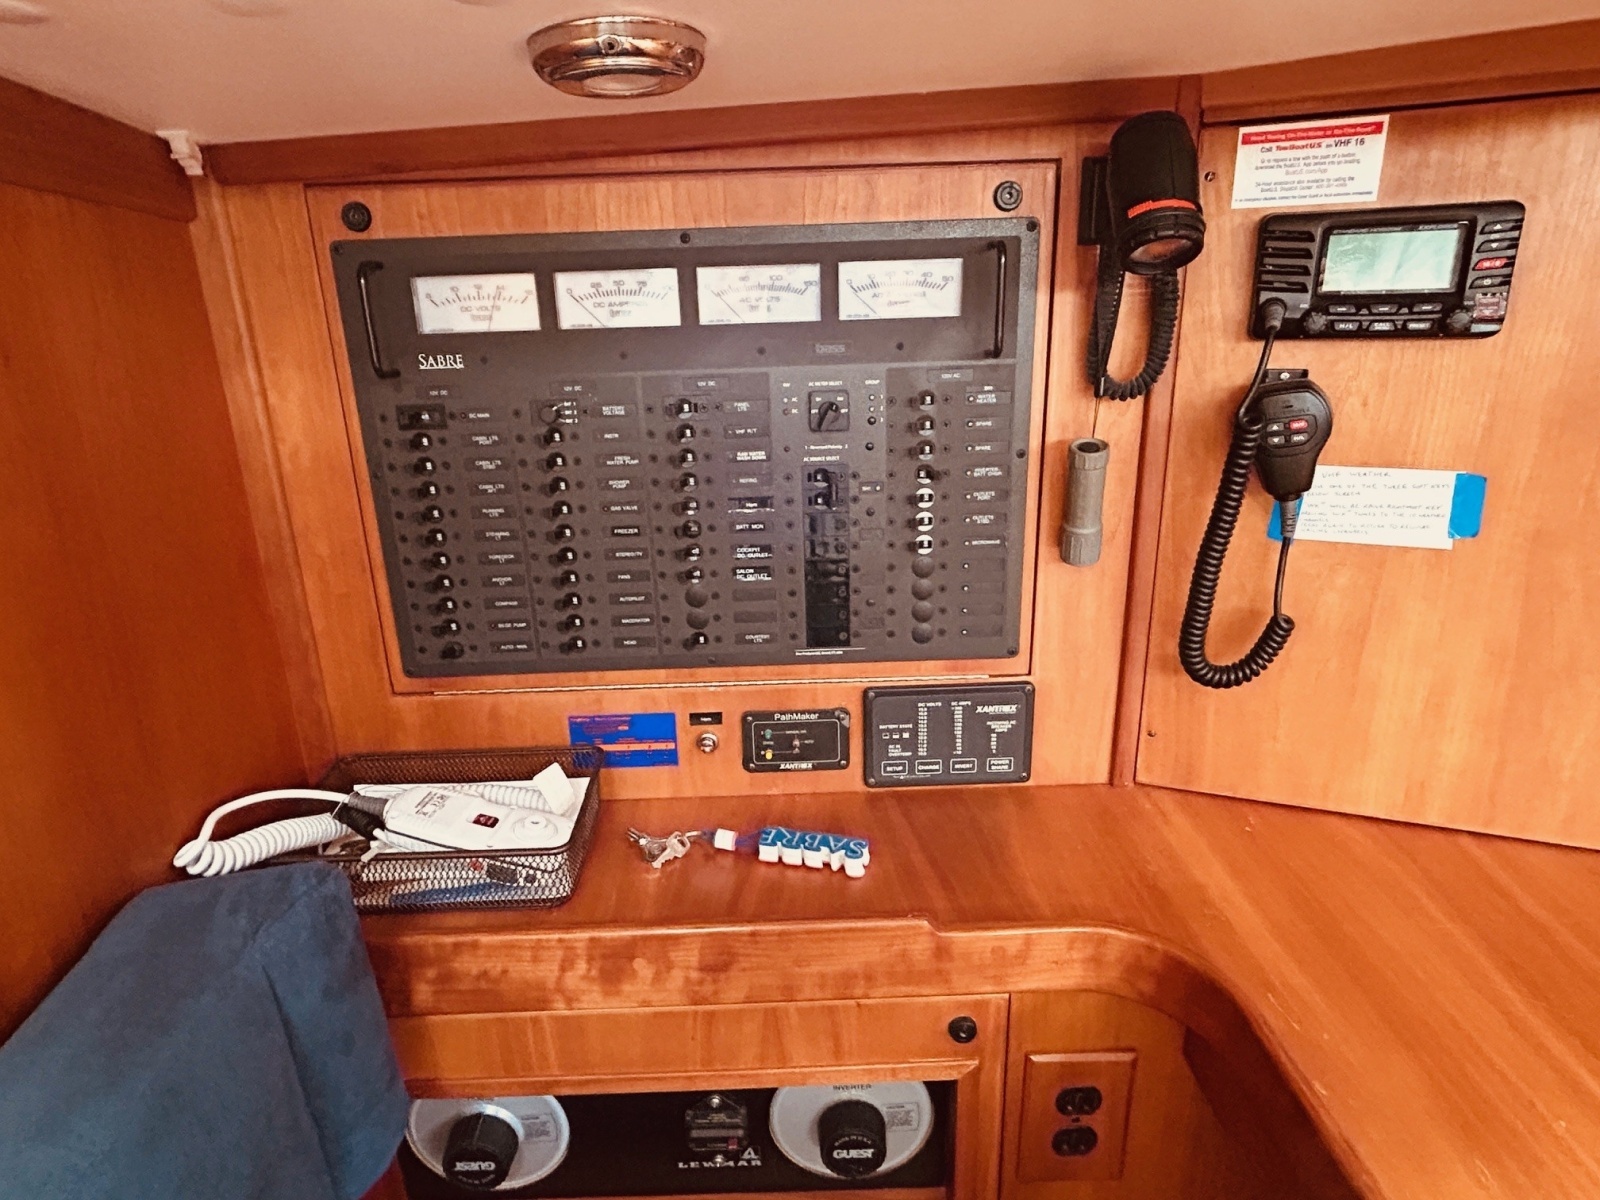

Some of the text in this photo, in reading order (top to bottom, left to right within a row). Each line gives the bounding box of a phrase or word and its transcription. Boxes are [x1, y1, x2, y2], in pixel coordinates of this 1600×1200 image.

[1334, 138, 1351, 147] VHF
[418, 353, 464, 369] SABRE
[976, 705, 1018, 713] XANTREX
[760, 826, 869, 859] SABRE
[832, 1148, 875, 1159] GUEST
[454, 1161, 496, 1171] GUEST
[678, 1160, 762, 1168] LEWMAR
